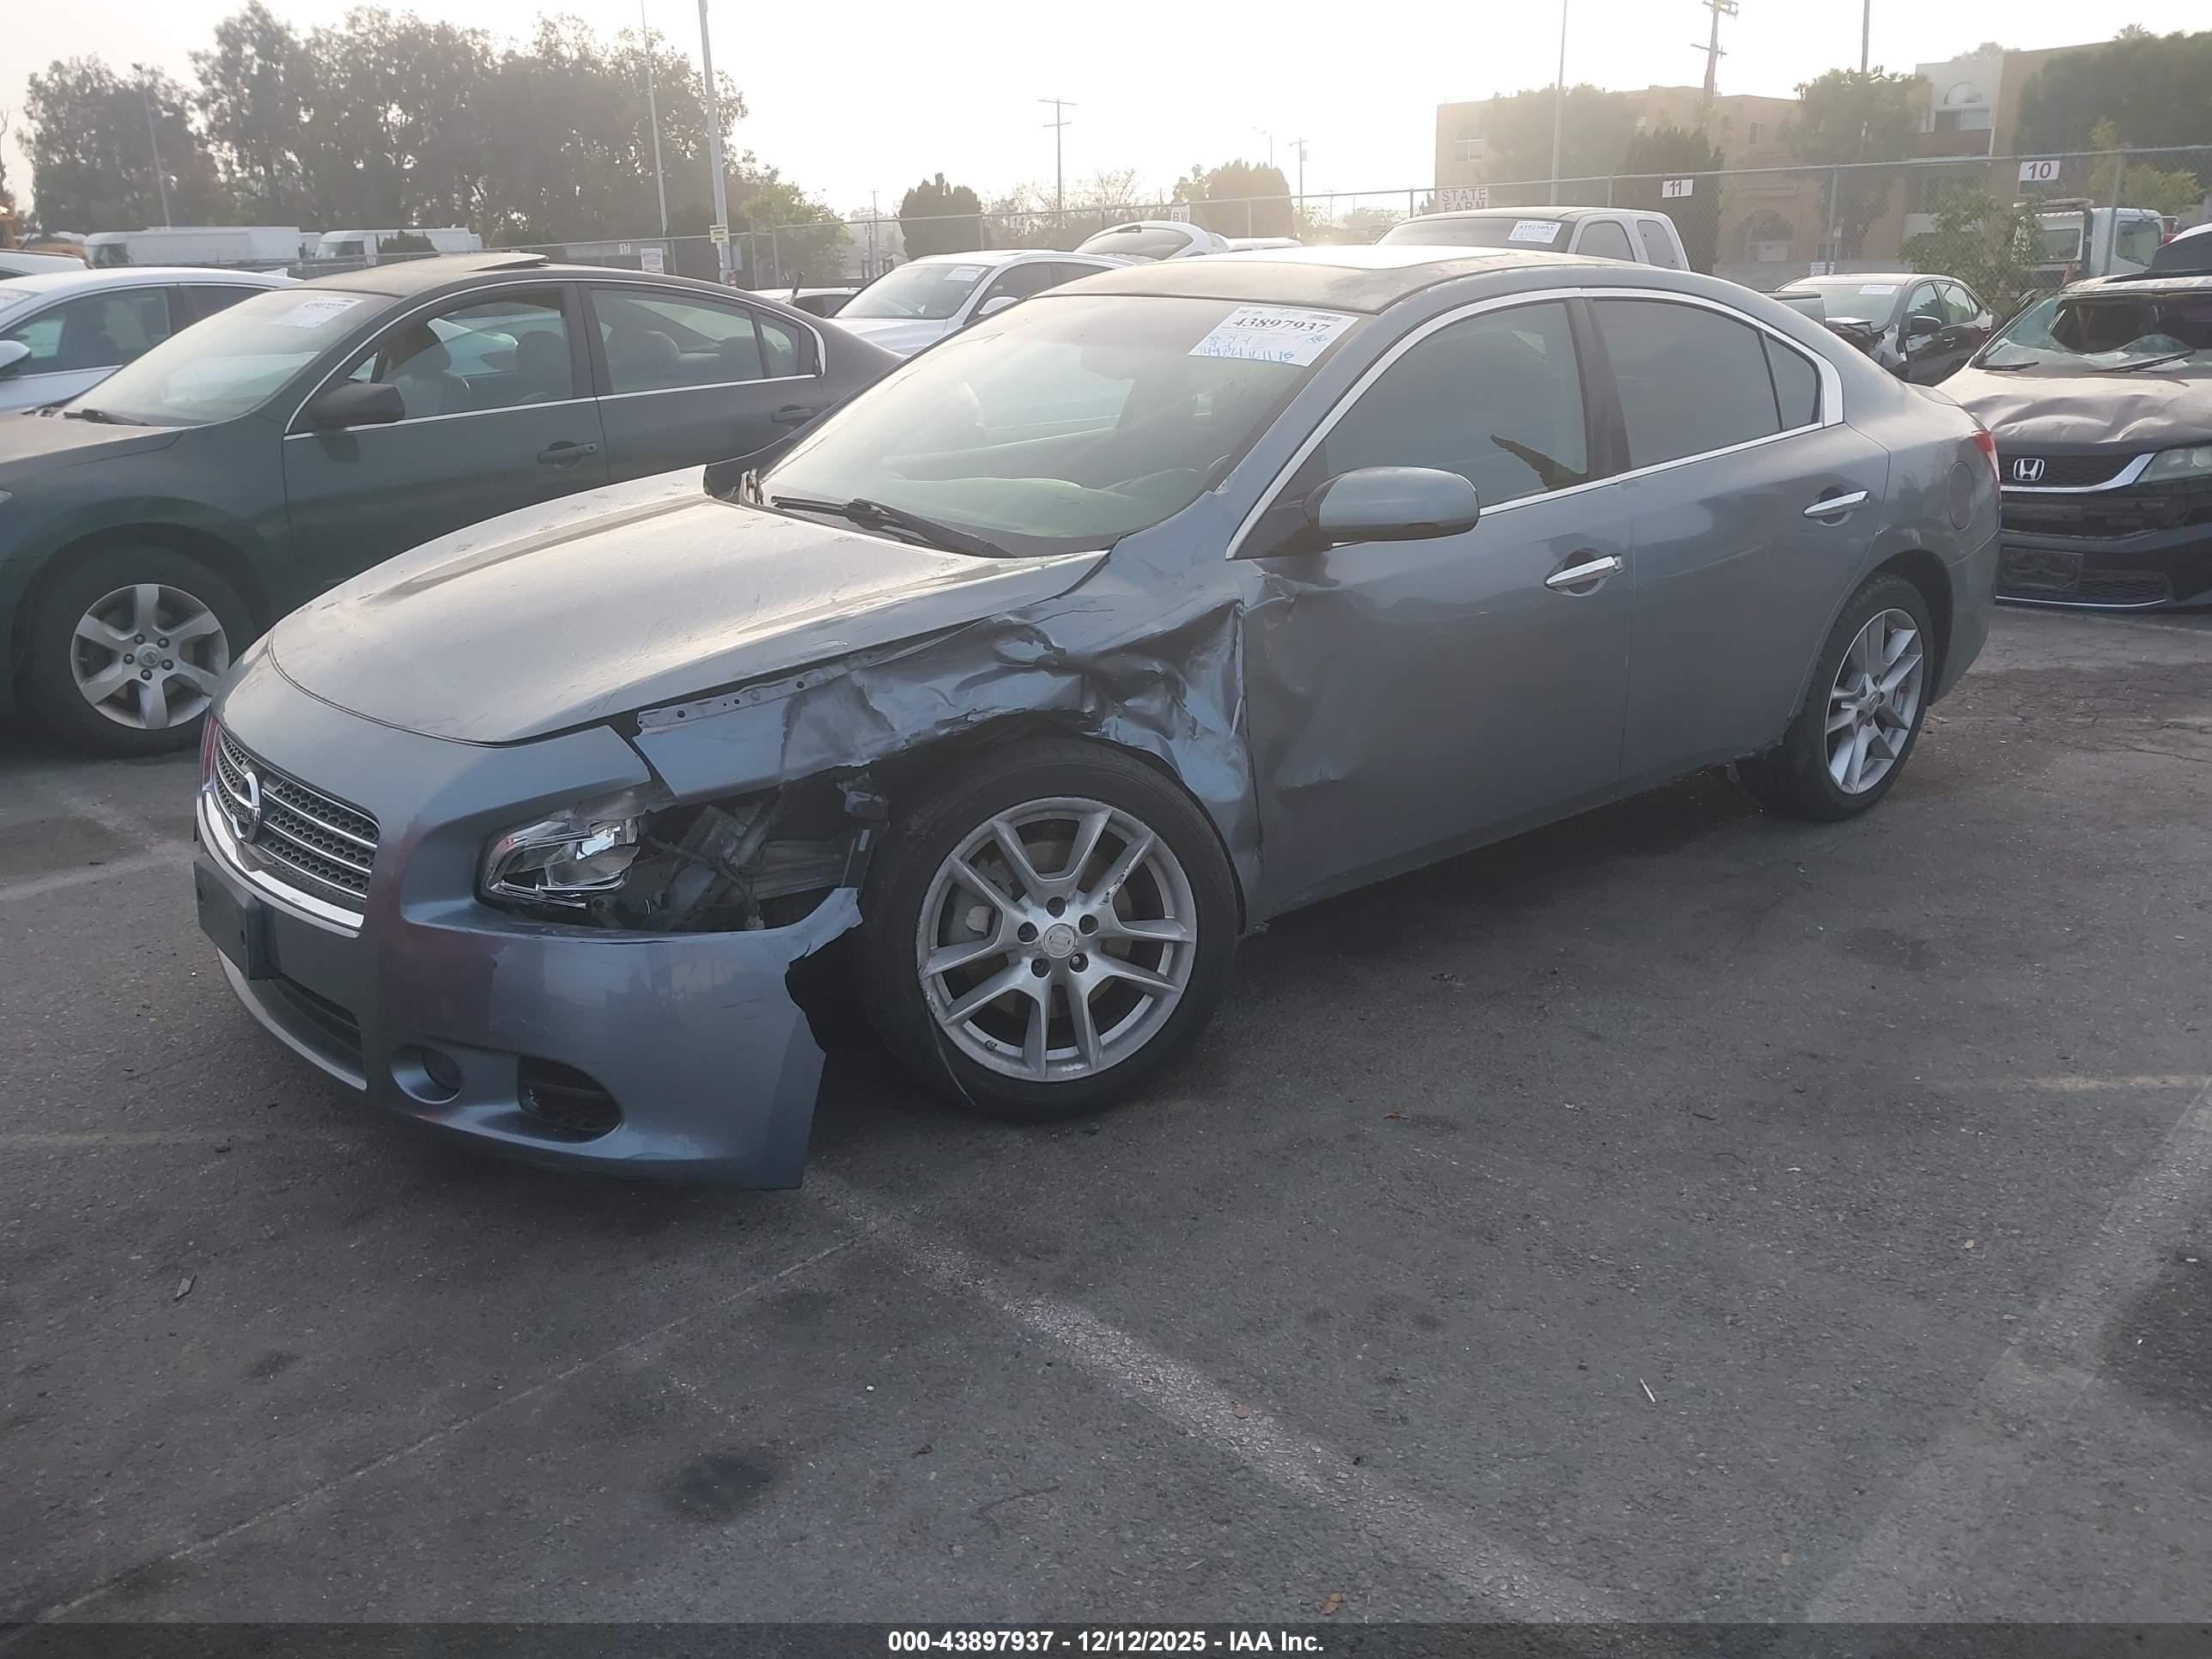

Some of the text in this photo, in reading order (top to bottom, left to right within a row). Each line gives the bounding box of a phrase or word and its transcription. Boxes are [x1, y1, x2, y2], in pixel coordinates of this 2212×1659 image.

[2028, 162, 2051, 179] 10
[1443, 188, 1486, 202] STATE
[1668, 180, 1682, 196] 11
[1444, 200, 1486, 212] FARM
[1232, 317, 1332, 333] 43897937
